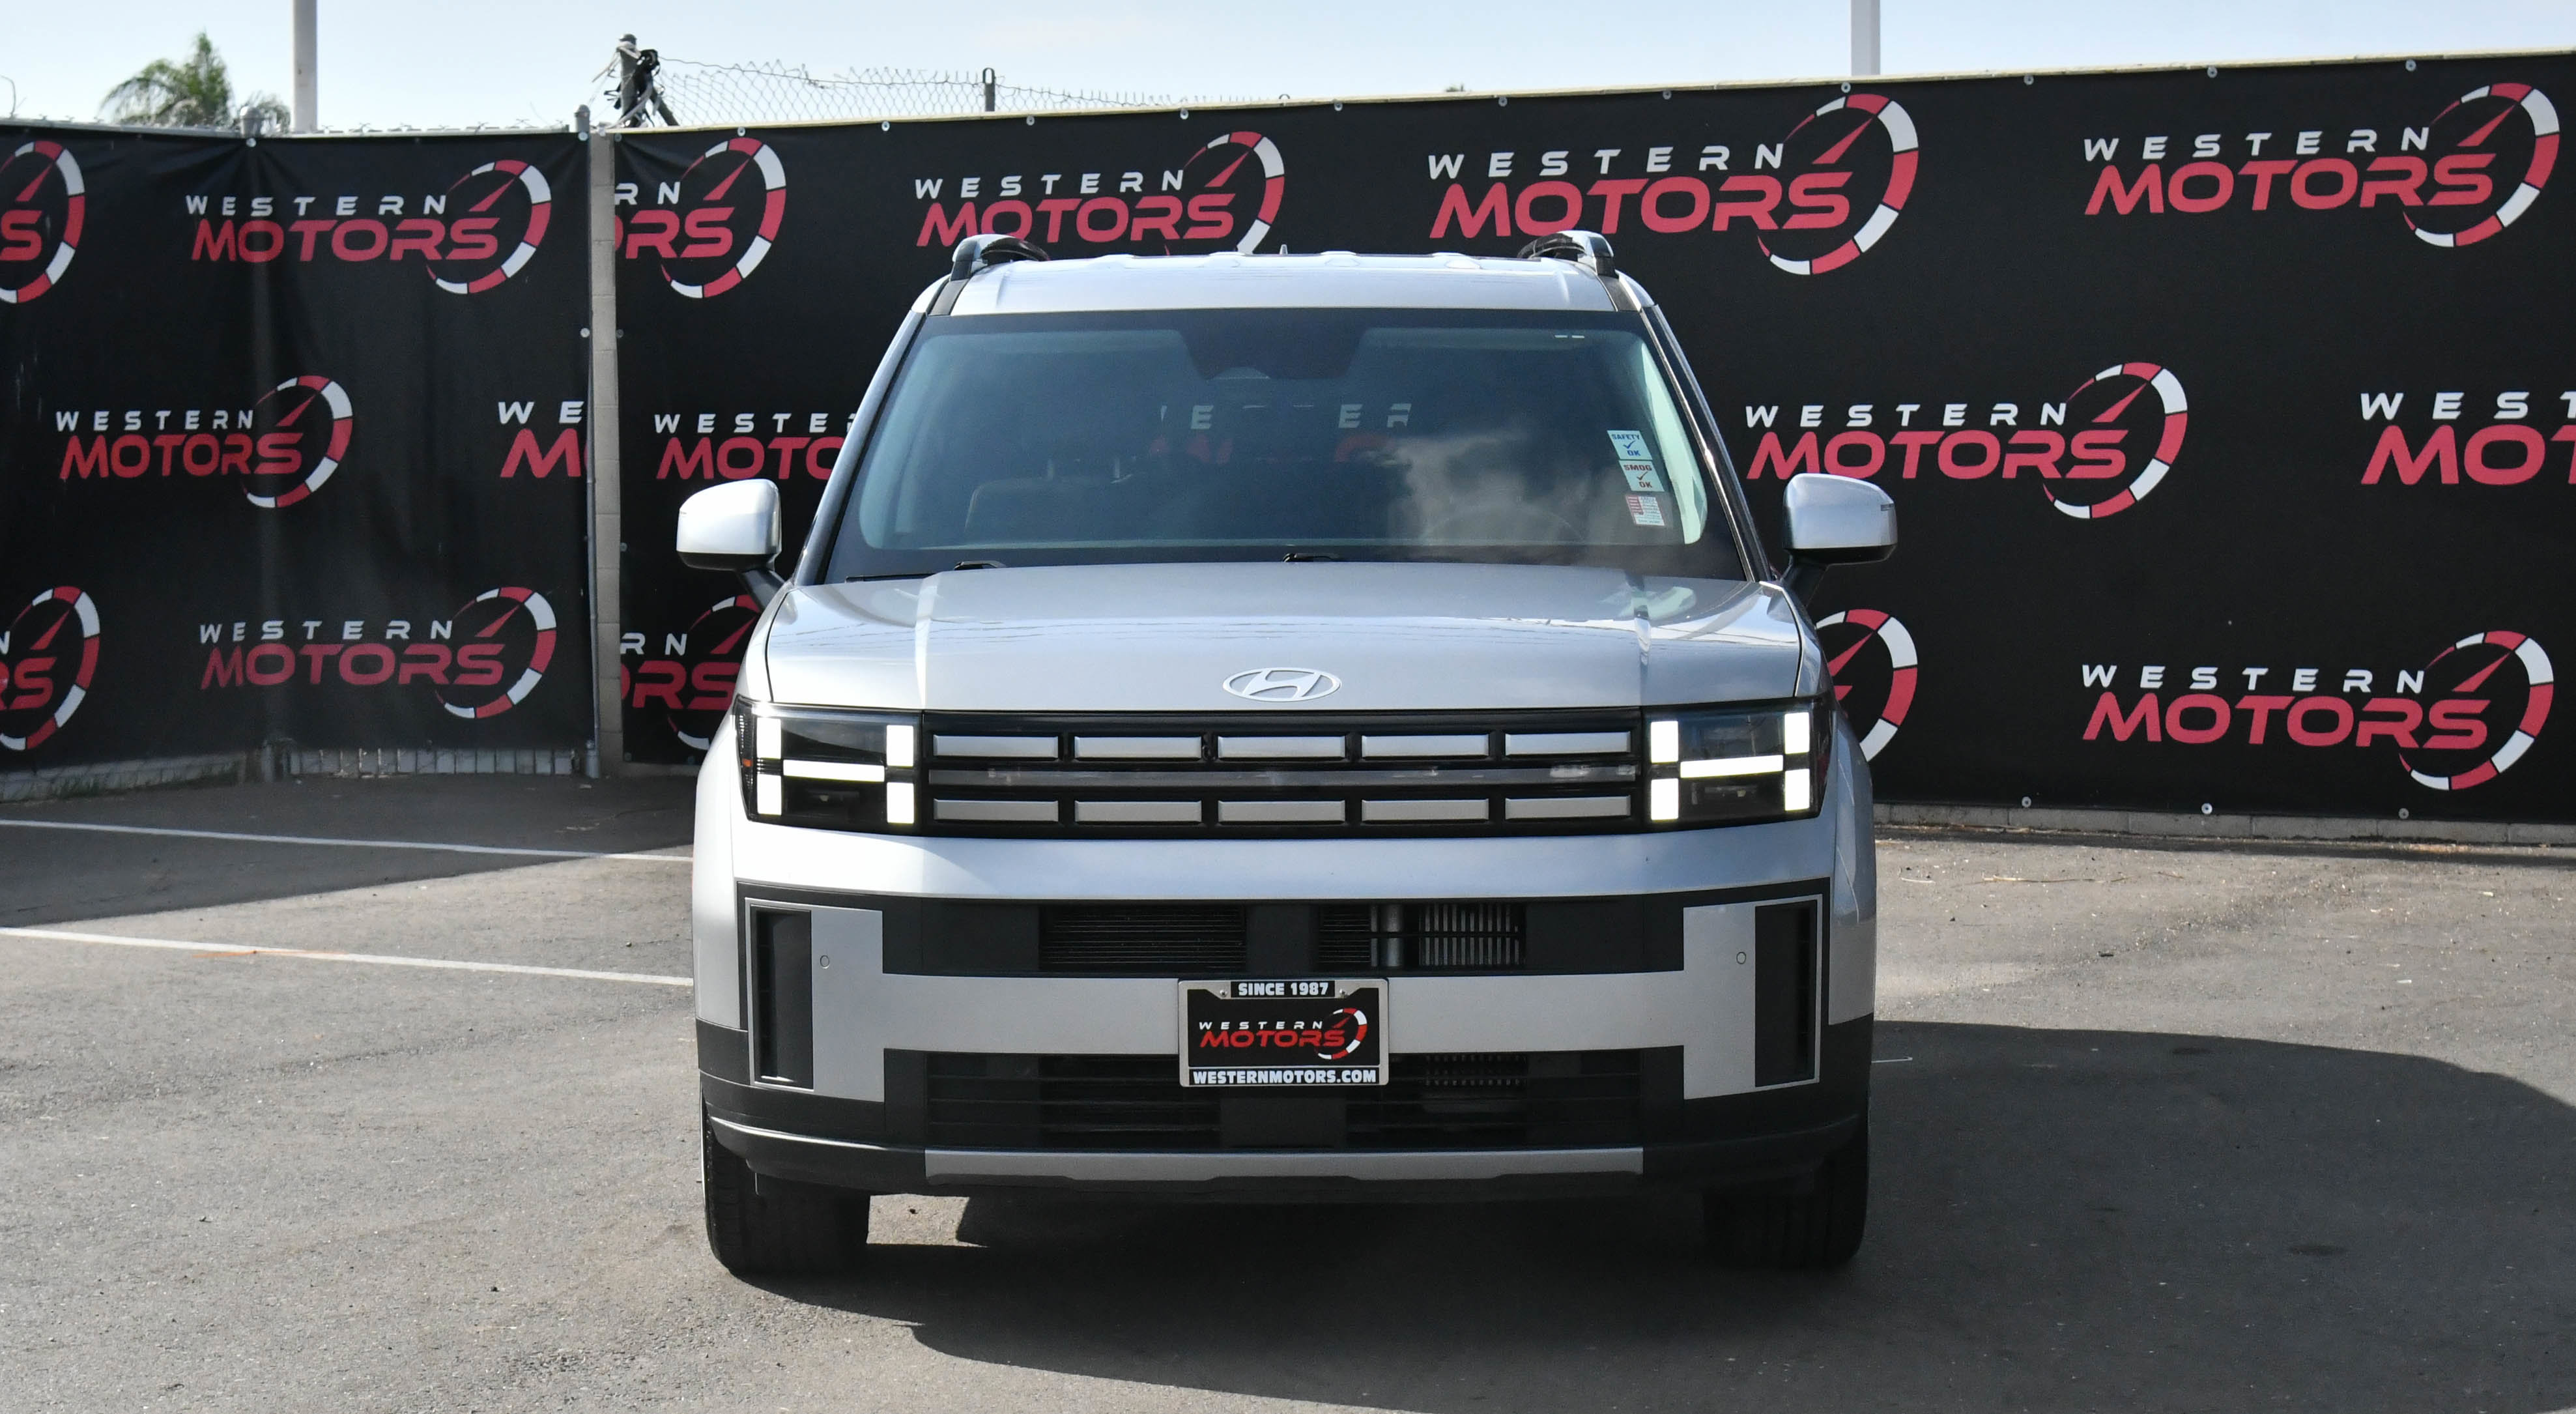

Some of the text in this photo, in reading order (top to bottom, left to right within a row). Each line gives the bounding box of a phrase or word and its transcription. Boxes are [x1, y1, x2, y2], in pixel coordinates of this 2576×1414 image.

[2083, 126, 2429, 162] WESTERN
[1428, 143, 1784, 180] WESTERN
[915, 169, 1184, 199] WESTERN
[2085, 152, 2497, 216] MOTORS
[186, 195, 446, 217] WESTERN
[917, 192, 1236, 247] MOTORS
[1429, 171, 1853, 239] MOTORS
[192, 217, 500, 263] MOTORS
[56, 410, 253, 431] WESTERN
[1745, 402, 2067, 428] WESTERN
[59, 432, 303, 480] MOTORS
[1747, 429, 2129, 480] MOTORS
[200, 620, 453, 644] WESTERN
[202, 643, 504, 689] MOTORS
[2082, 664, 2425, 694] WESTERN
[2082, 691, 2491, 750] MOTORS
[1238, 982, 1328, 996] SINCE 1987
[1199, 1020, 1323, 1030] WESTERN
[1199, 1030, 1345, 1048] MOTORS
[1193, 1069, 1377, 1084] WESTERNMOTORS.COM
